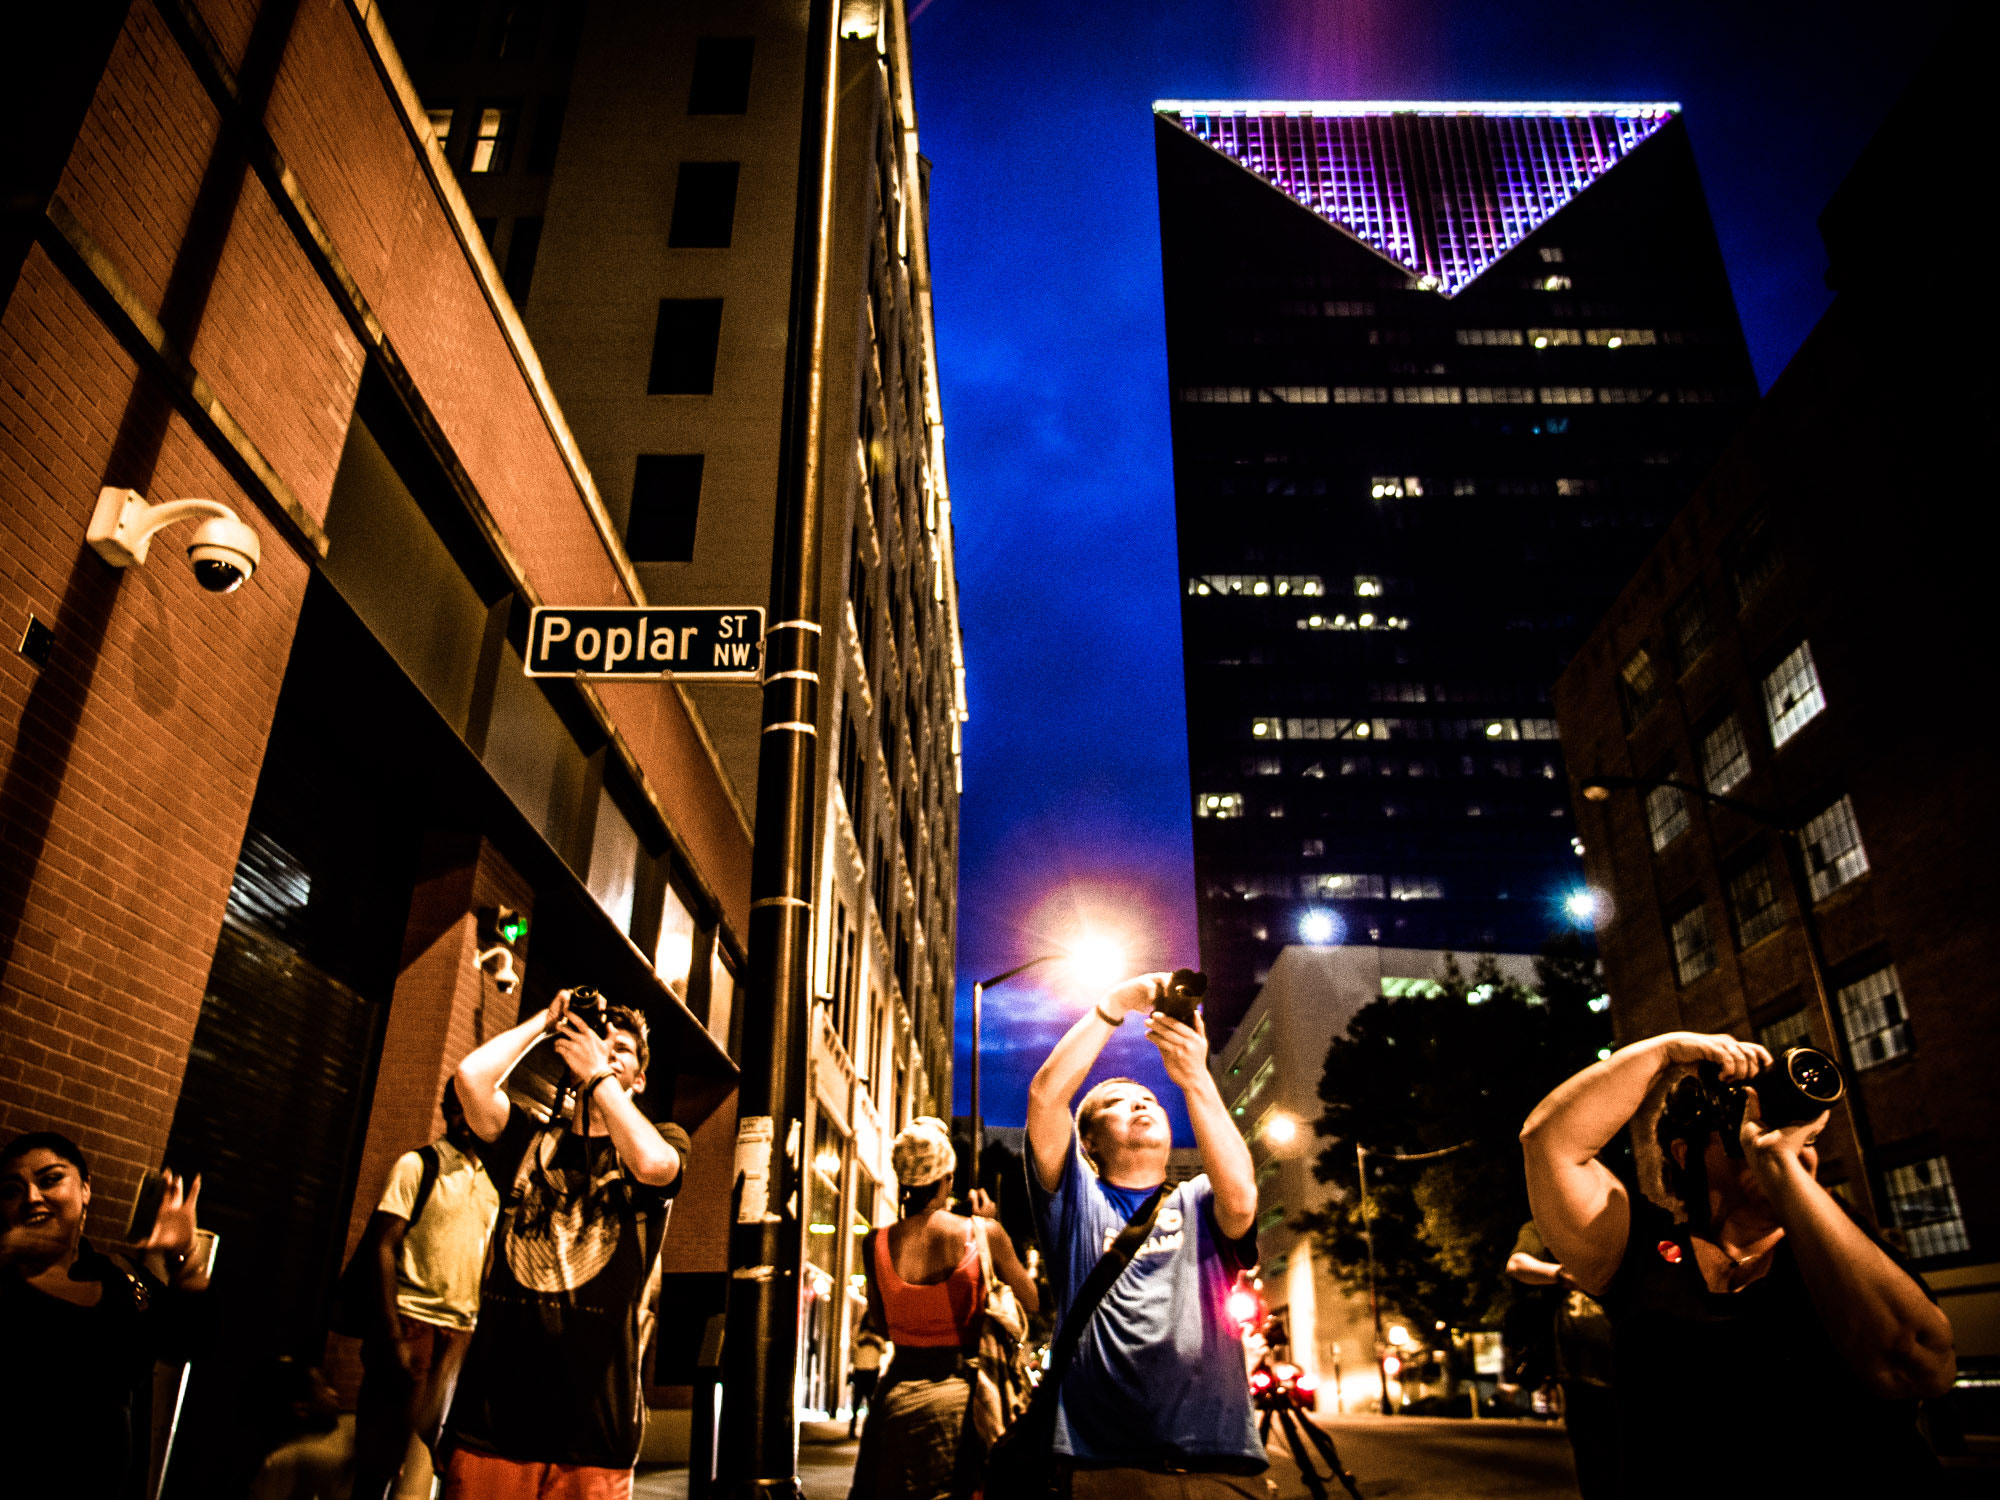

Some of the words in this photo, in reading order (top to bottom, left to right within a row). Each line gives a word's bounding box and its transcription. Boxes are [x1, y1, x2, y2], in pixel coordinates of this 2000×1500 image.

[540, 616, 699, 672] Poplar
[718, 615, 748, 639] ST
[713, 642, 751, 667] NW
